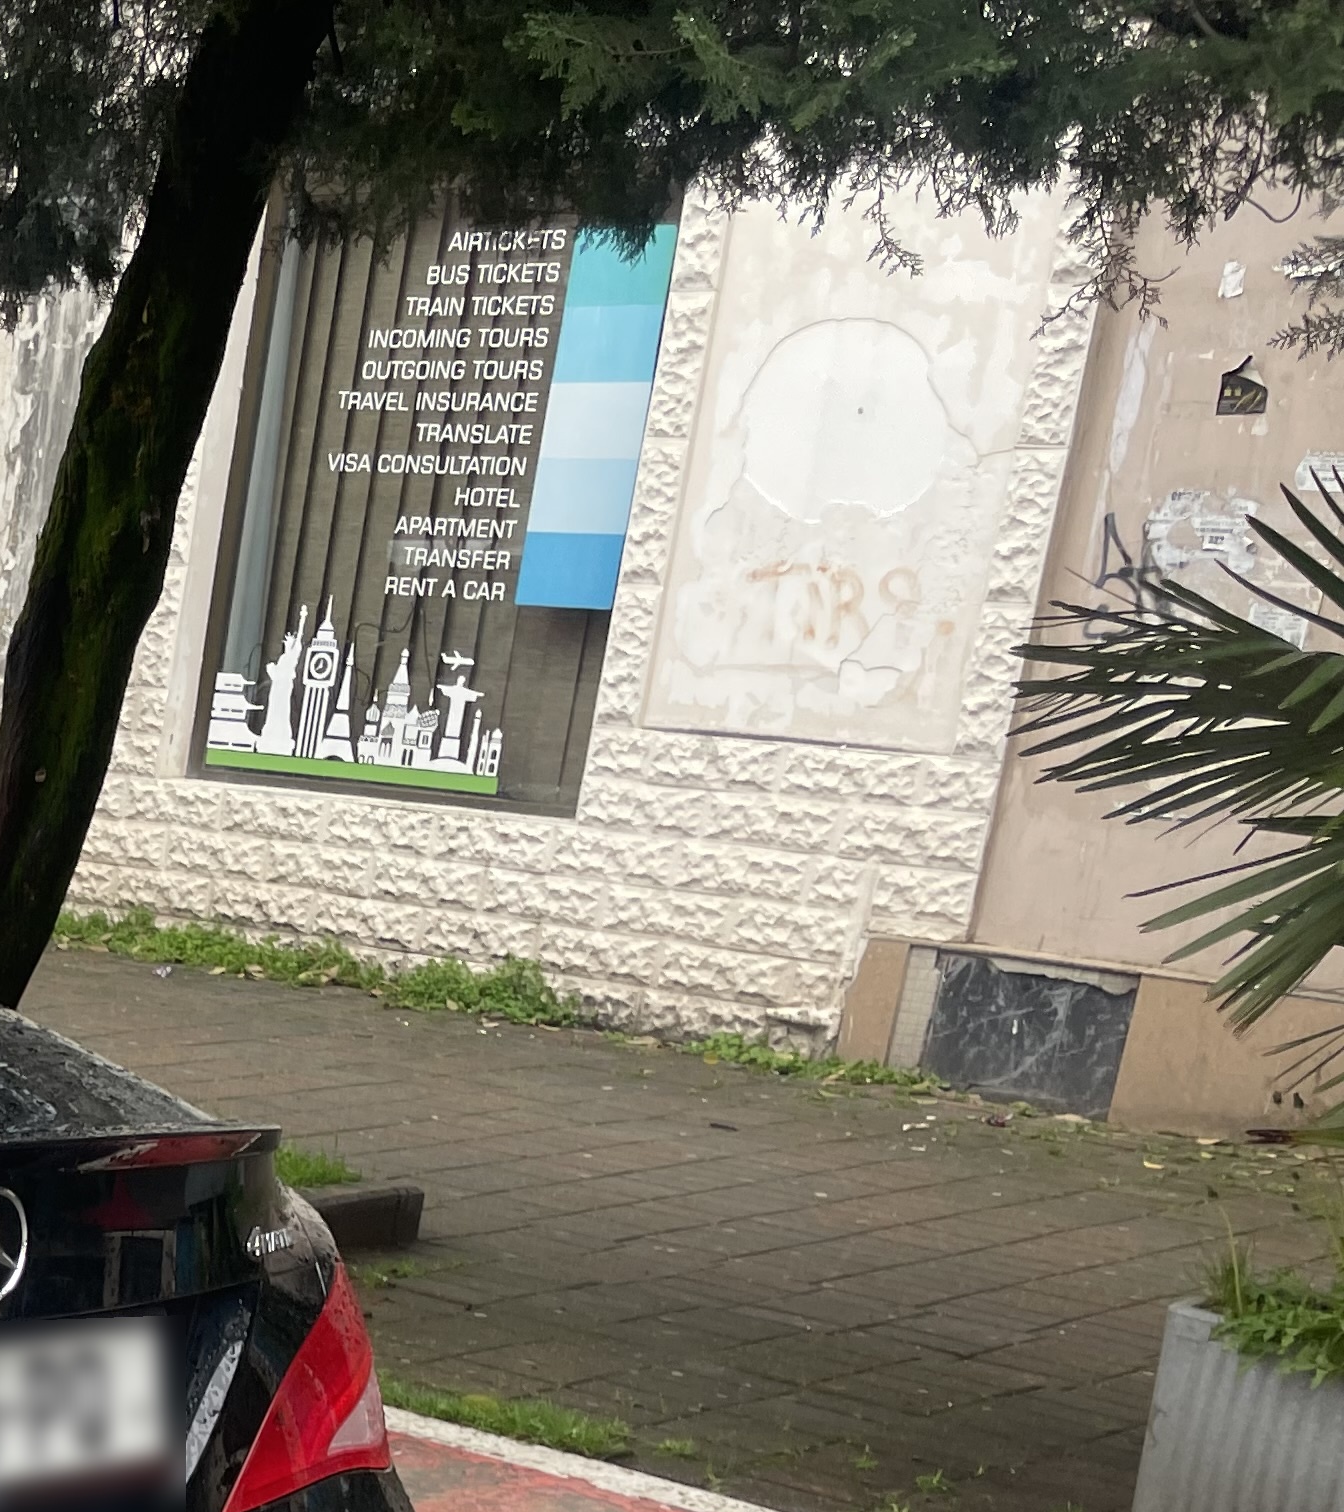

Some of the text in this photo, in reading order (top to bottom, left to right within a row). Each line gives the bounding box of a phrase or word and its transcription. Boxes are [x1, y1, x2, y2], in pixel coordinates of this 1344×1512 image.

[447, 229, 567, 252] AIRTICKETS
[426, 262, 561, 285] BUS TICKETS
[406, 295, 555, 316] TRAIN TICKETS
[368, 328, 550, 348] INCOMING TOURS
[362, 360, 544, 380] OUTGOING TOURS
[338, 391, 538, 412] TRAVEL INSURANCE
[416, 423, 533, 445] TRANSLATE
[328, 453, 527, 476] VISA CONSULTATION
[454, 487, 520, 508] HOTEL
[394, 516, 518, 539] APARTMENT
[404, 547, 511, 570] TRANSFER
[384, 577, 506, 601] RENT A CAR
